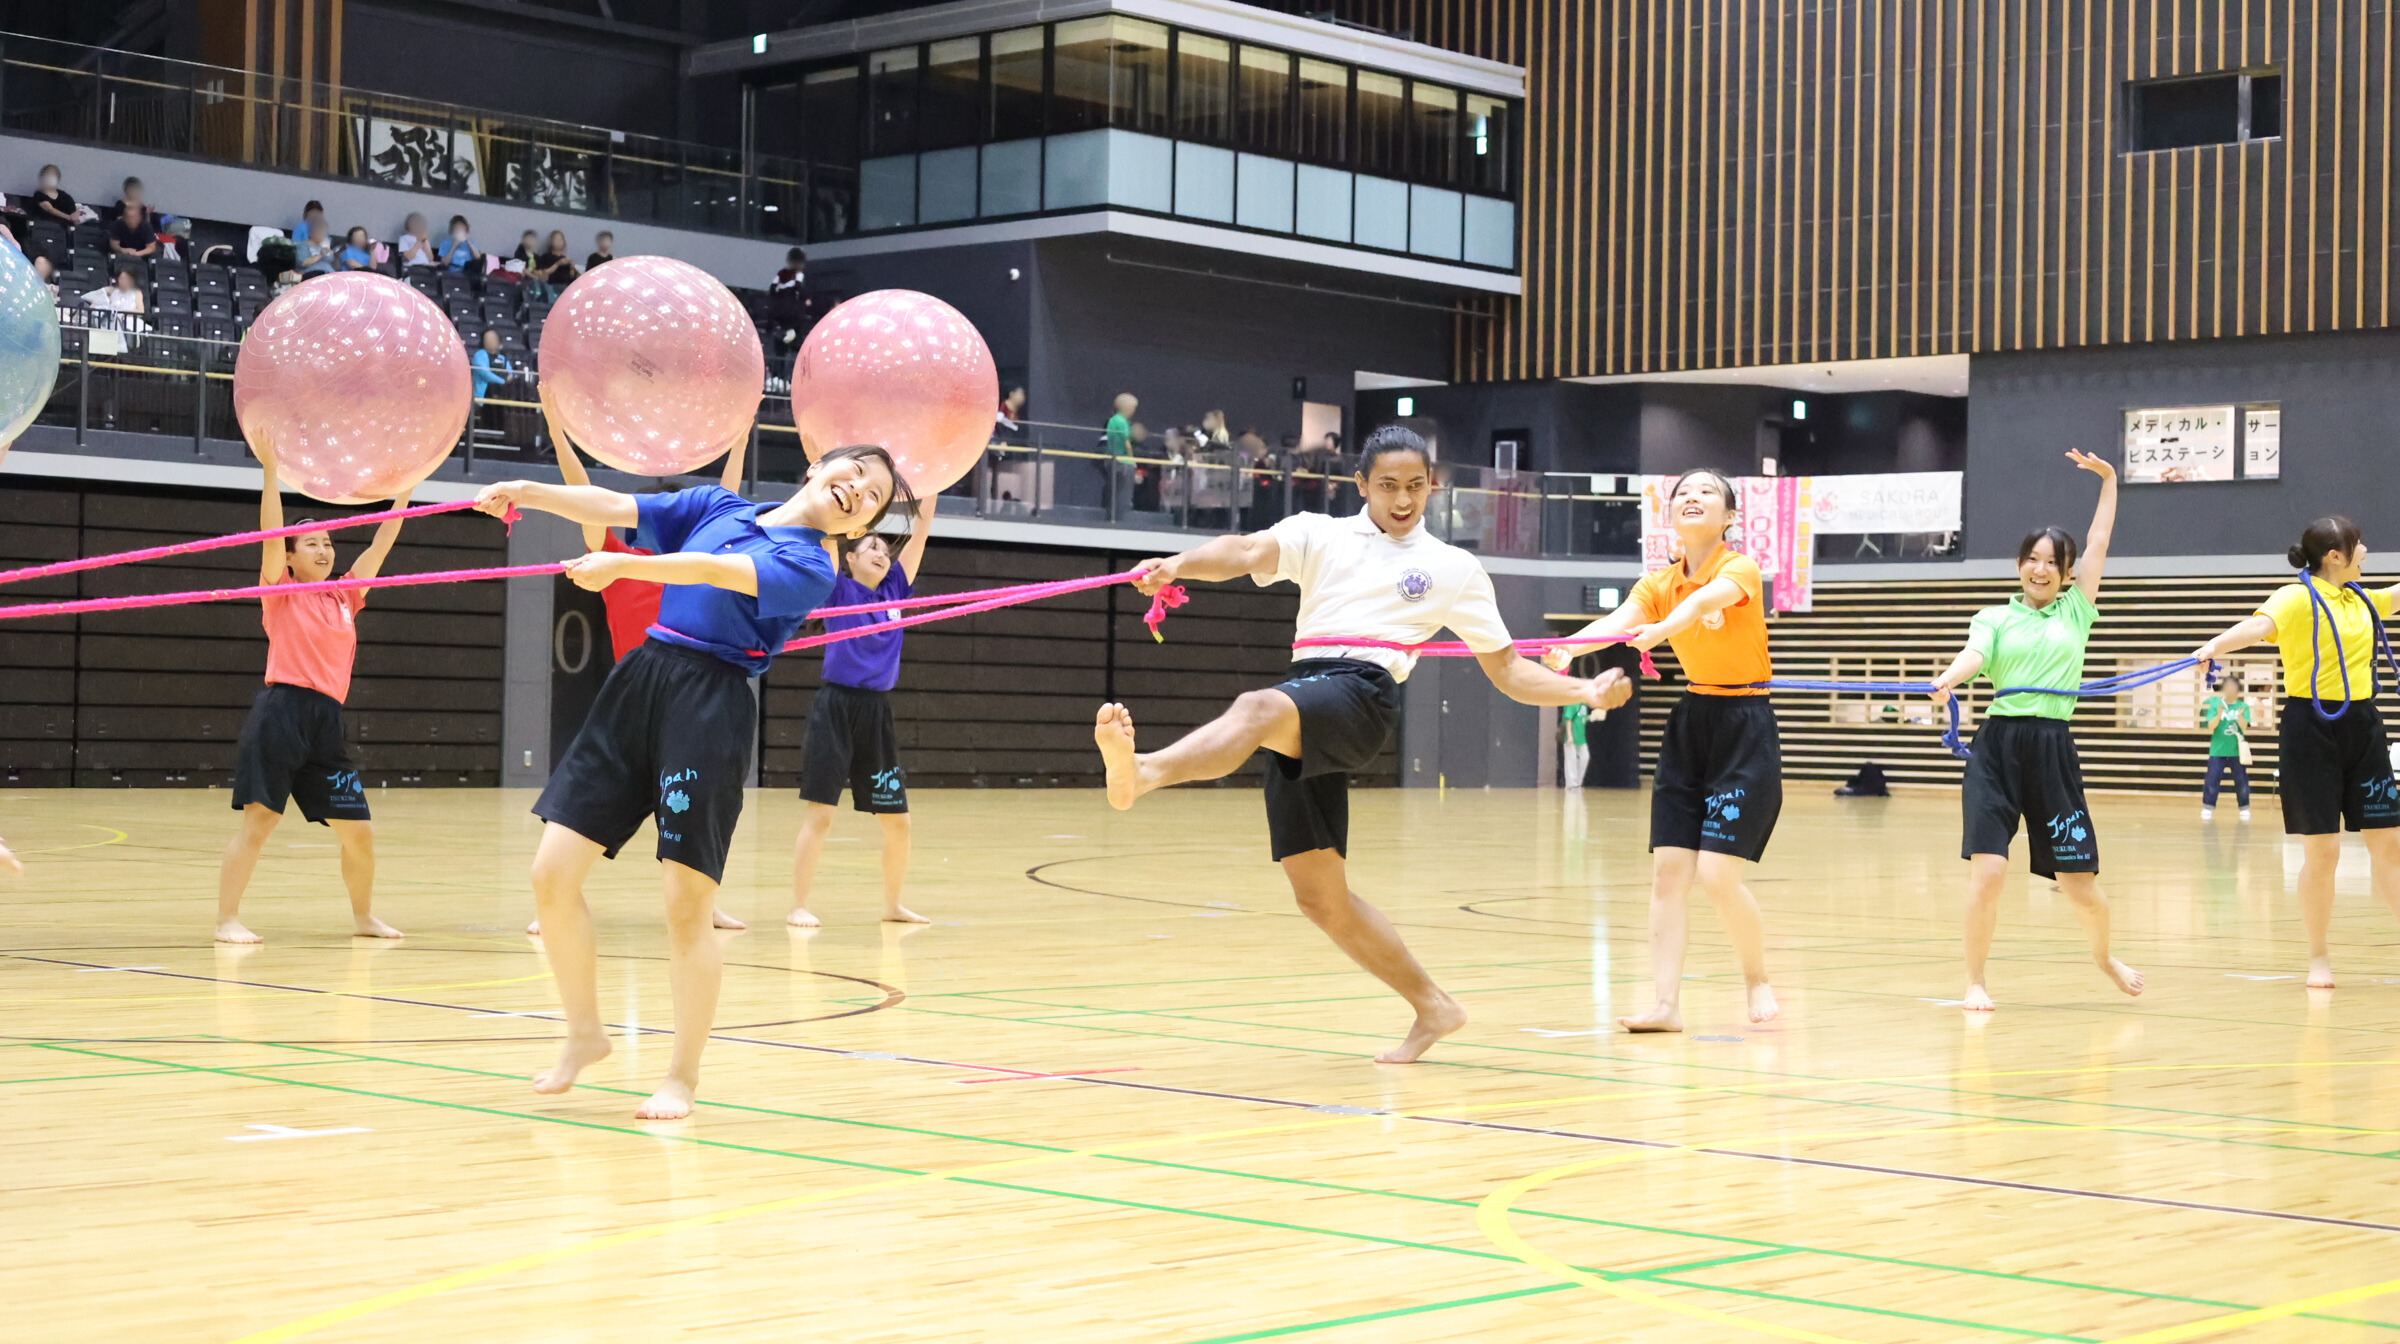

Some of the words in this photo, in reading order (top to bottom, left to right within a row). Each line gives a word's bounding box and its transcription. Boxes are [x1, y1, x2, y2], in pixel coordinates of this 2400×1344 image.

[1860, 489, 1939, 505] SAKURA
[1704, 788, 1746, 819] Japan
[2046, 809, 2085, 844] Japan
